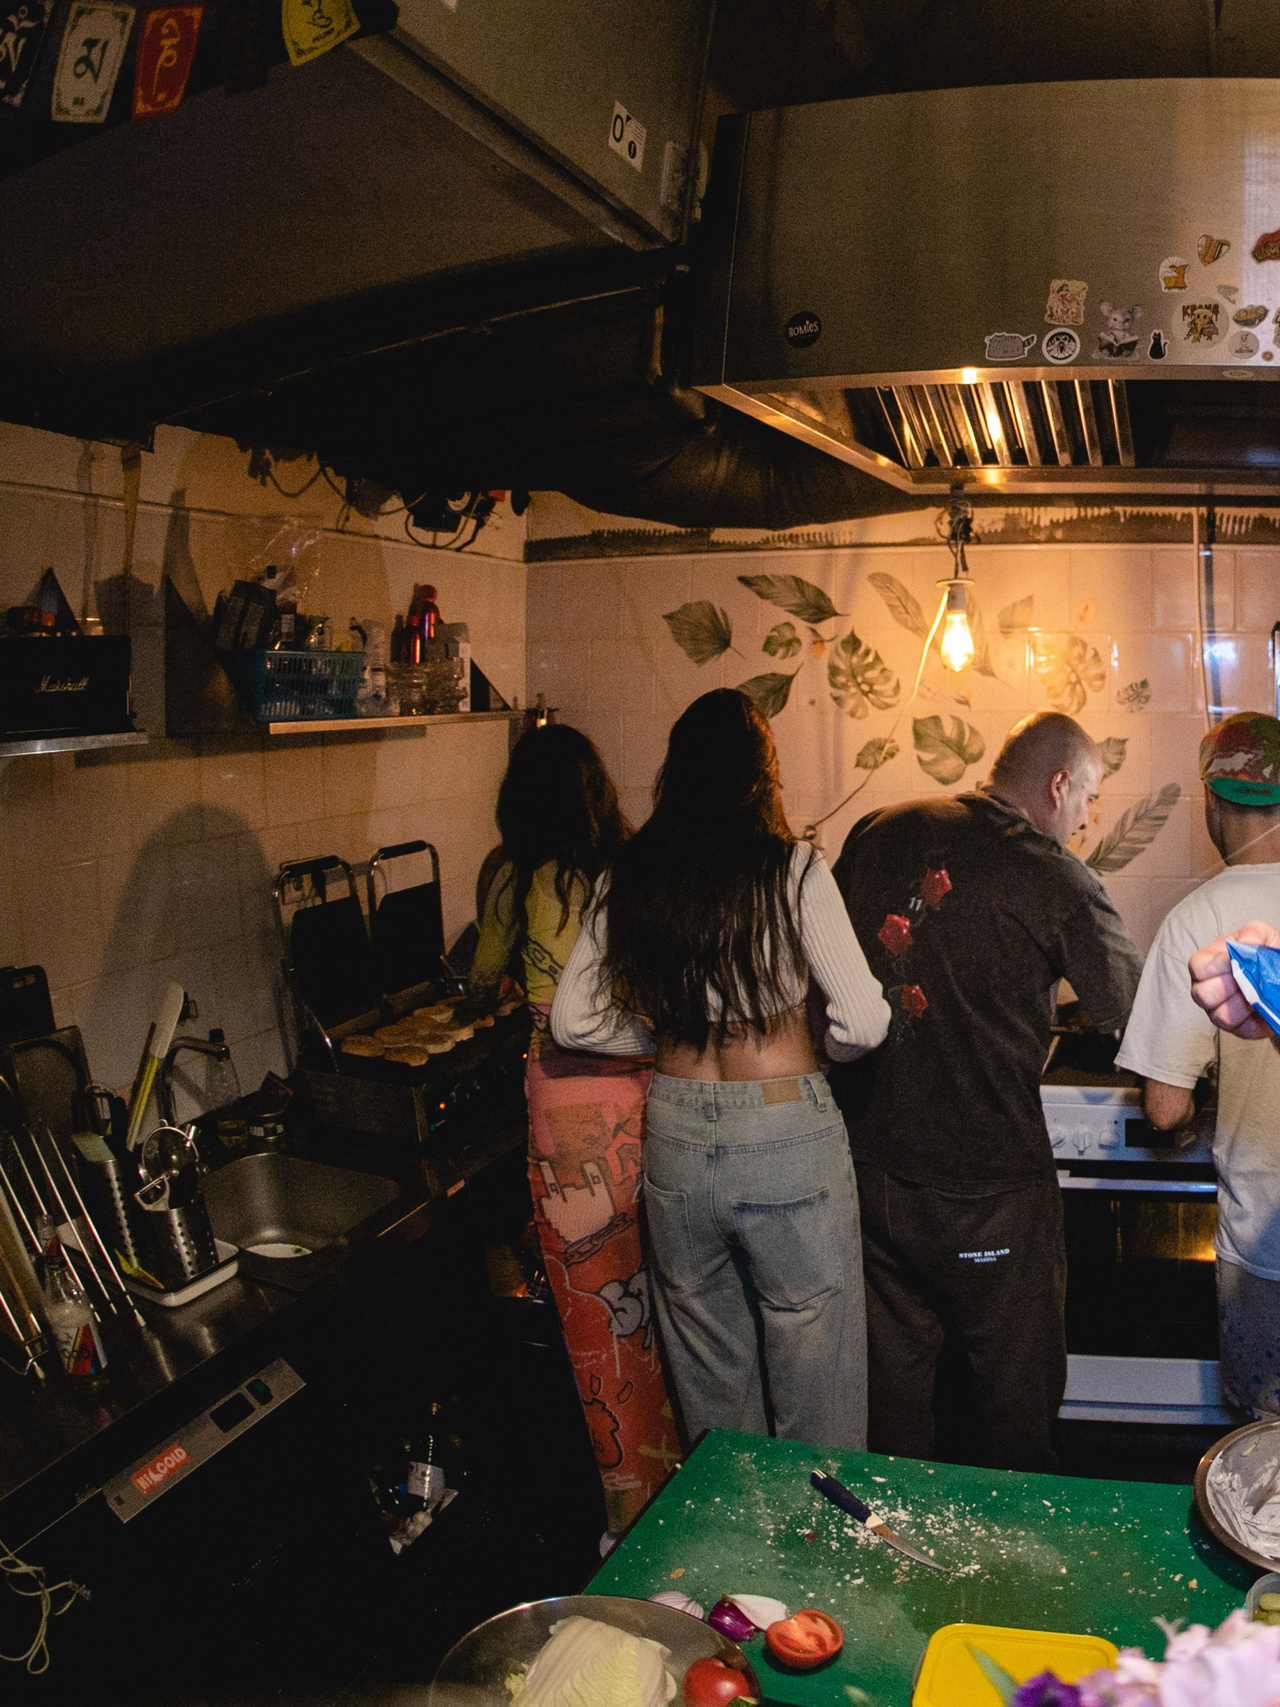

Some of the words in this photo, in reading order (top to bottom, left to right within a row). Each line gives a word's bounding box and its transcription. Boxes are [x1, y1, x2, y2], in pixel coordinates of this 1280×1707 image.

[33, 673, 90, 693] Marshall
[958, 1251, 983, 1259] STONE
[983, 1248, 1011, 1257] ISLAND
